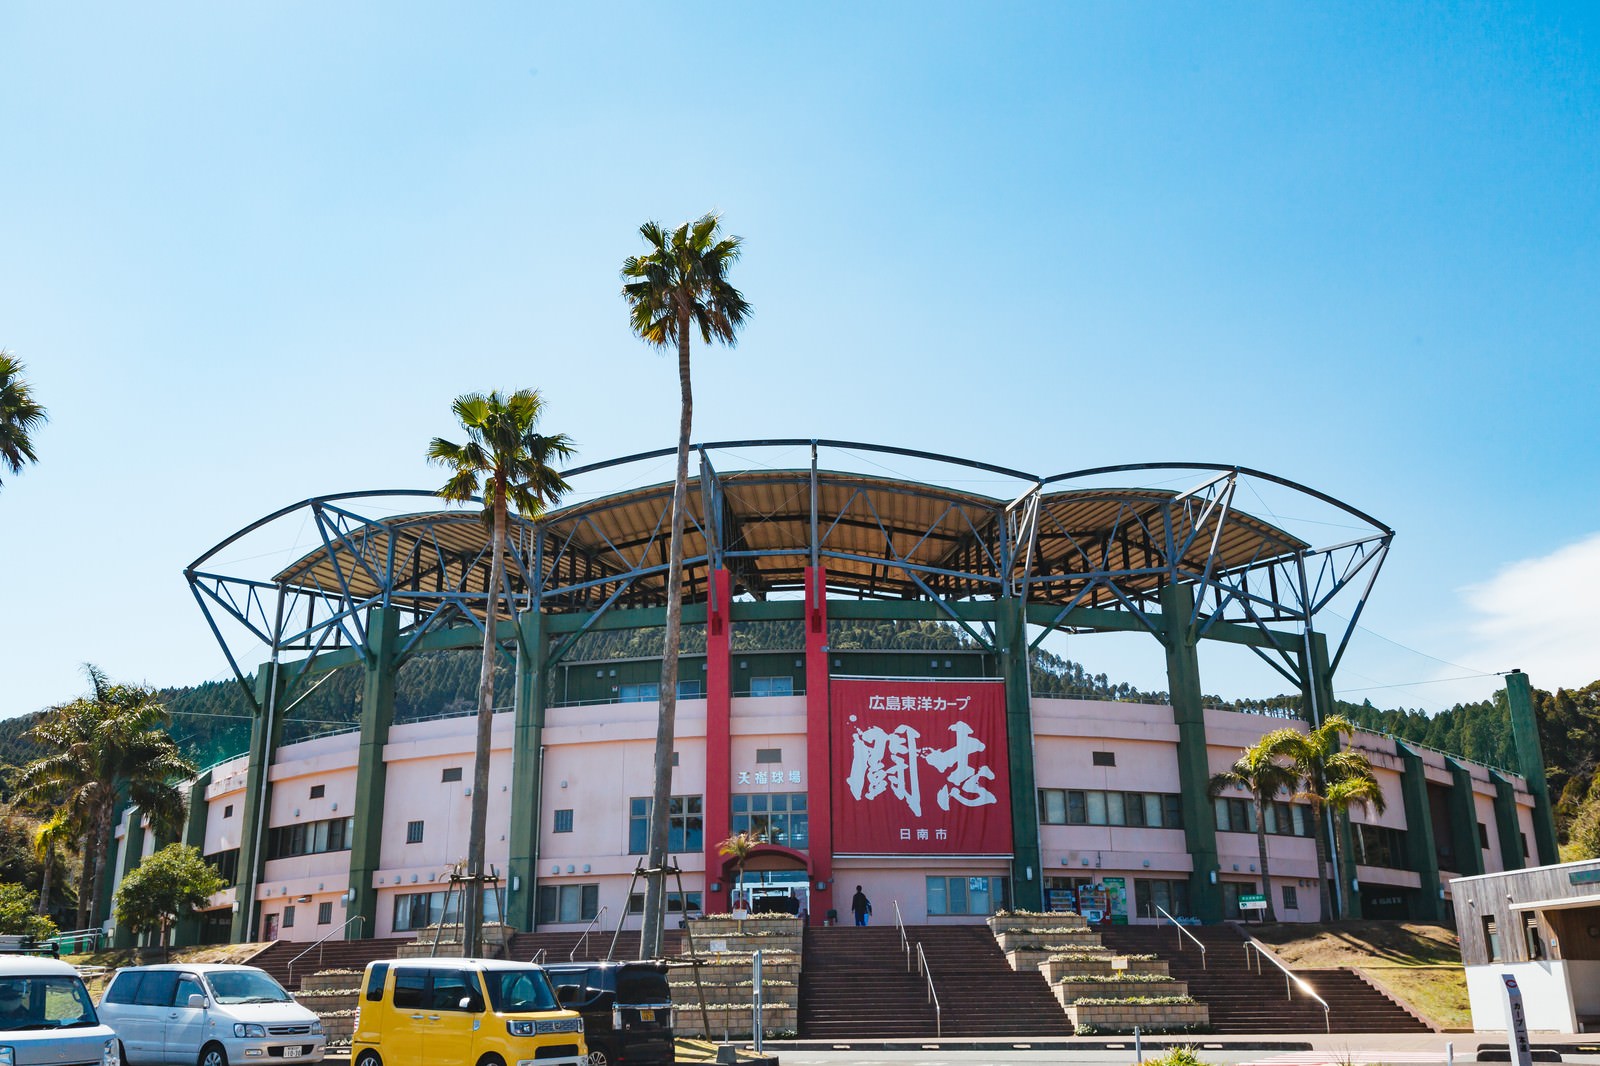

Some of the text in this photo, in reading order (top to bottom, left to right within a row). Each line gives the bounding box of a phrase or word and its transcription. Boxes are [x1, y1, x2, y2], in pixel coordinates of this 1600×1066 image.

[868, 695, 971, 711] 広島東洋カープ
[846, 718, 998, 817] 闘志
[737, 769, 801, 785] 天福球場
[899, 828, 947, 841] 日南市
